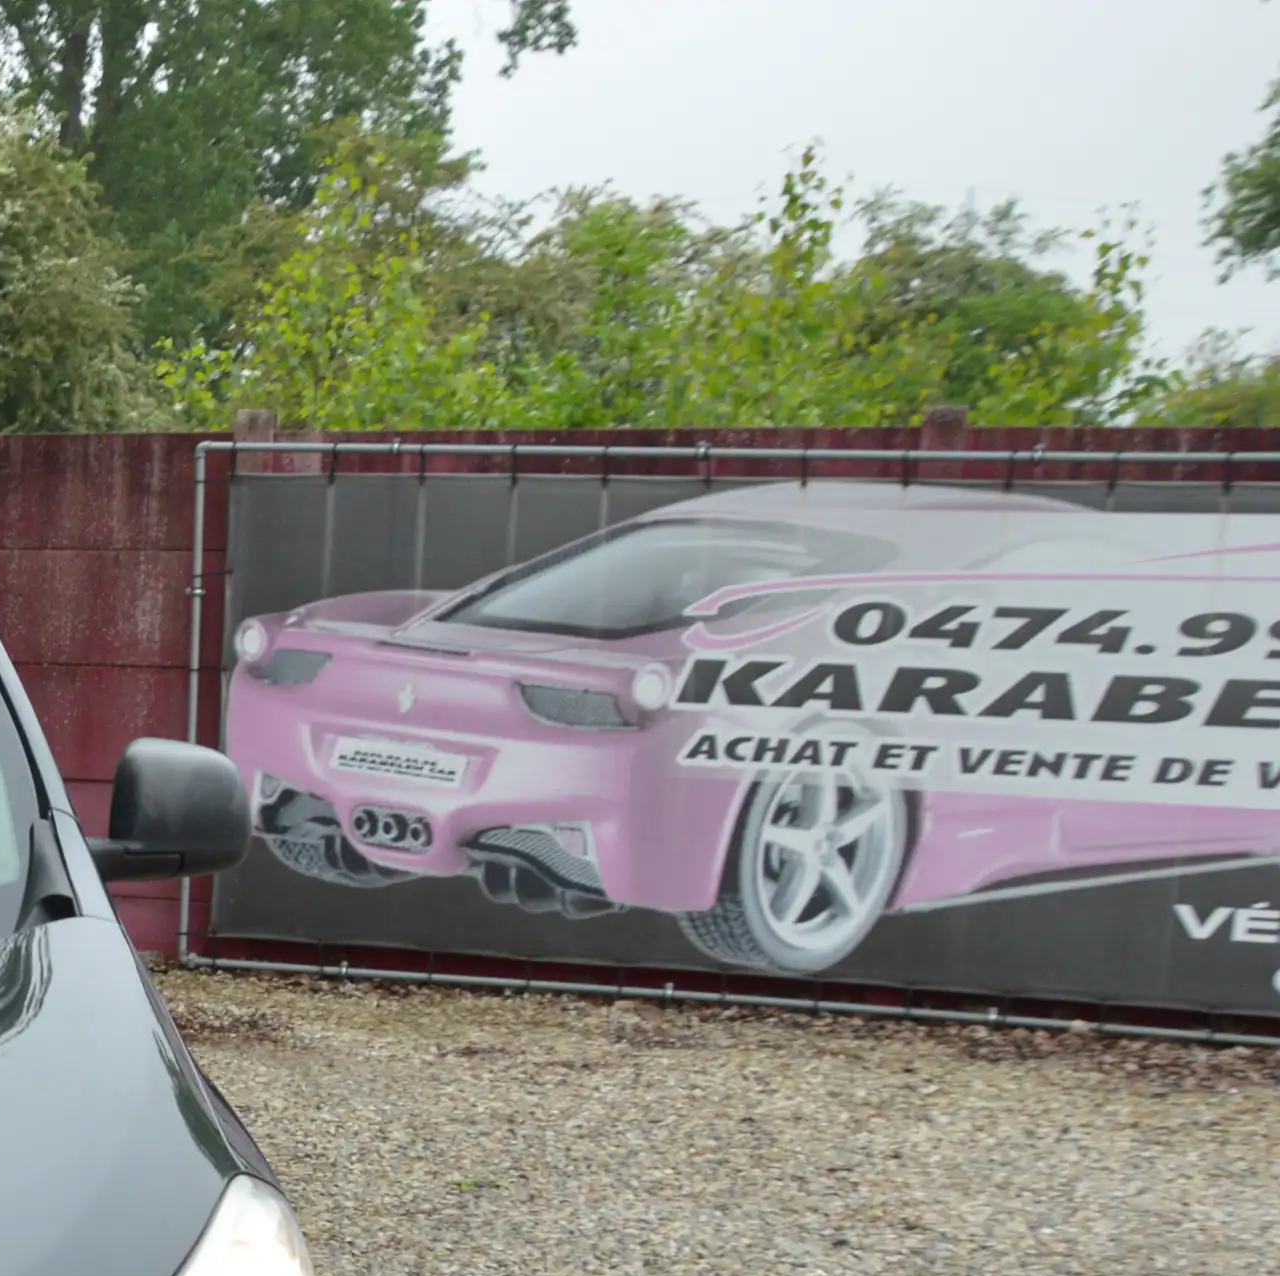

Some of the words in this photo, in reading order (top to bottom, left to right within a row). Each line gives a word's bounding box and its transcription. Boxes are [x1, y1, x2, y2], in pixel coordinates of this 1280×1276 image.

[833, 601, 1280, 661] 0474.9
[685, 734, 858, 767] ACHAT
[872, 743, 939, 772] ET
[958, 747, 1138, 783] VENTE
[1151, 757, 1236, 787] DE
